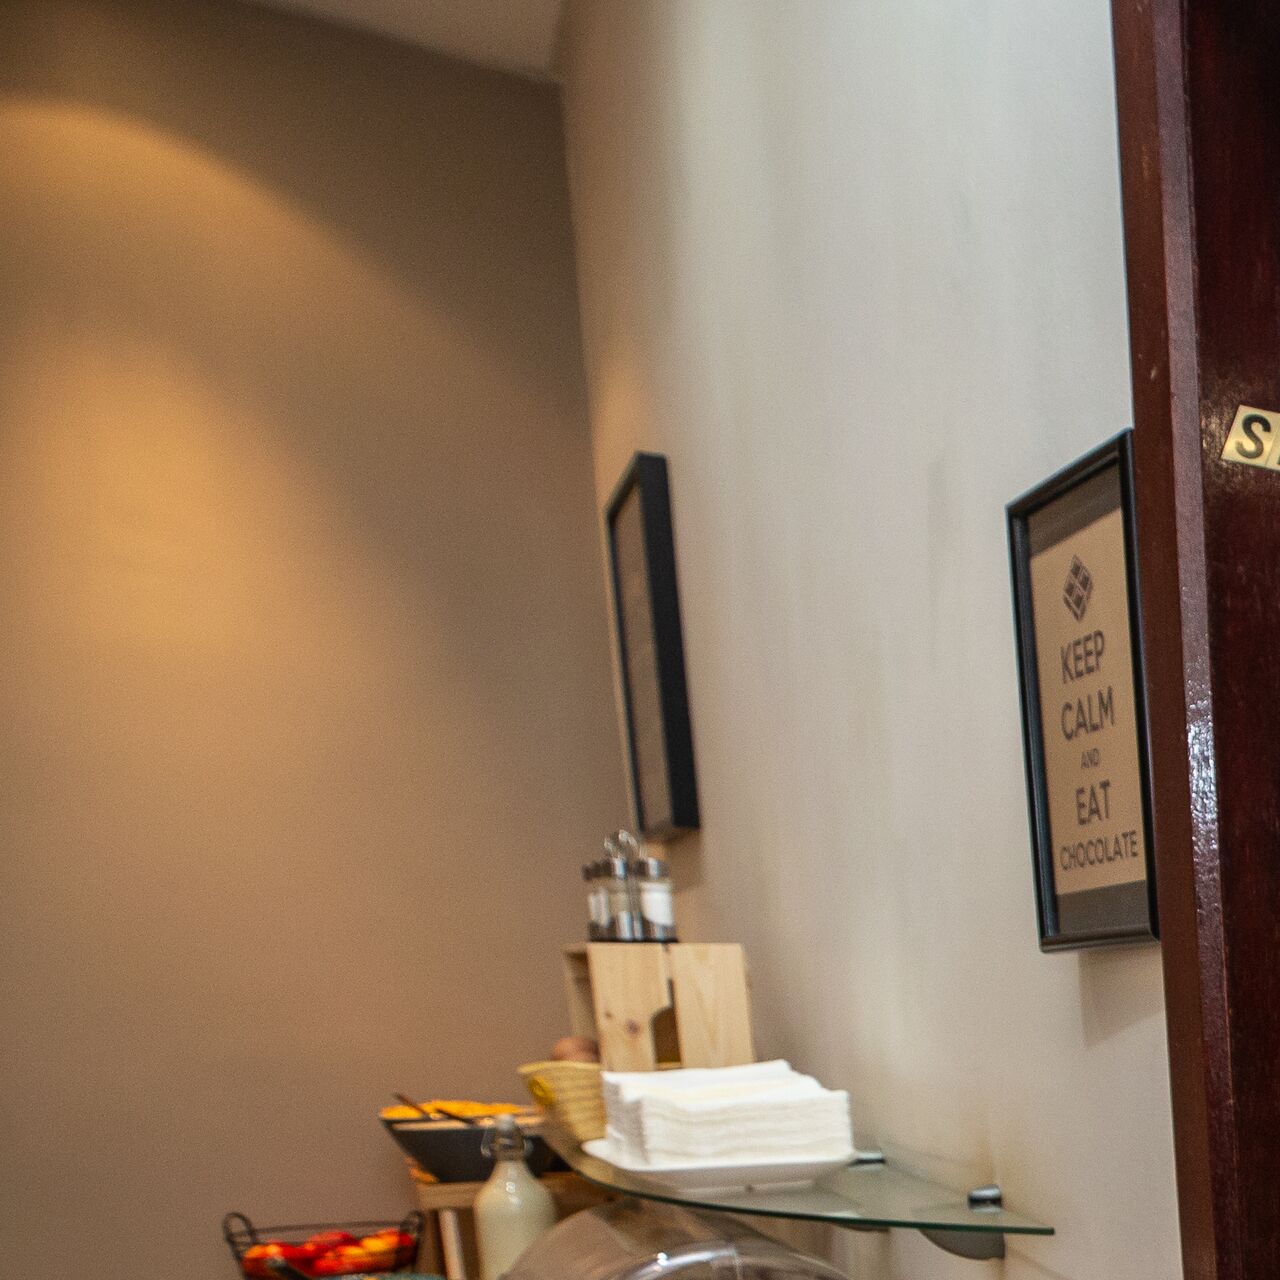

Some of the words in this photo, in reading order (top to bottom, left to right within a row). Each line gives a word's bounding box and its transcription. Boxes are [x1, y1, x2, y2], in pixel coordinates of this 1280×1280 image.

[1061, 629, 1104, 684] KEEP
[1061, 685, 1114, 740] CALM
[1081, 748, 1099, 768] AND
[1076, 779, 1110, 825] EAT
[1060, 830, 1138, 871] CHOCOLATE
